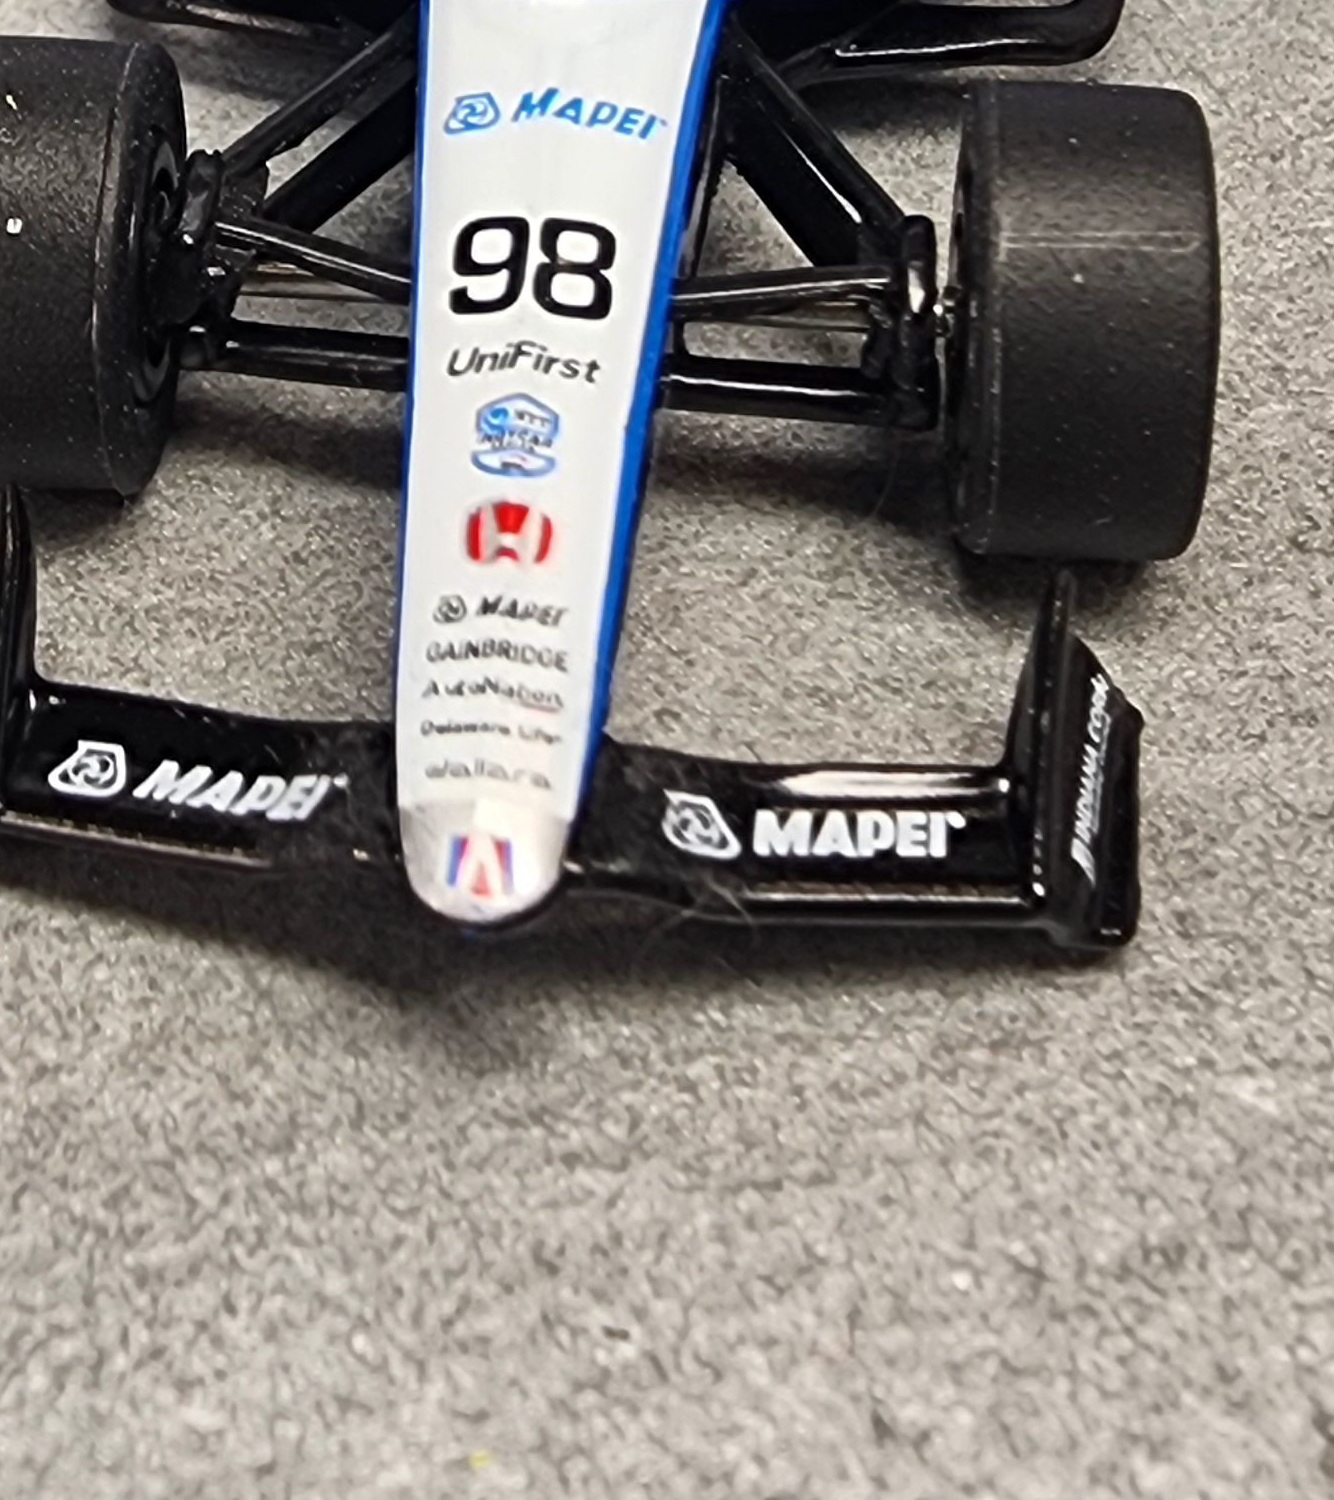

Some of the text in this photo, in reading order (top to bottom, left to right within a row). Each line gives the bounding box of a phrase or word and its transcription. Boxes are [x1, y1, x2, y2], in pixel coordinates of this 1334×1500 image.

[511, 87, 668, 140] MAPEI
[448, 215, 617, 321] 98
[446, 340, 601, 384] UniFirst
[132, 759, 349, 821] MAPEI
[753, 809, 966, 858] MAPEI
